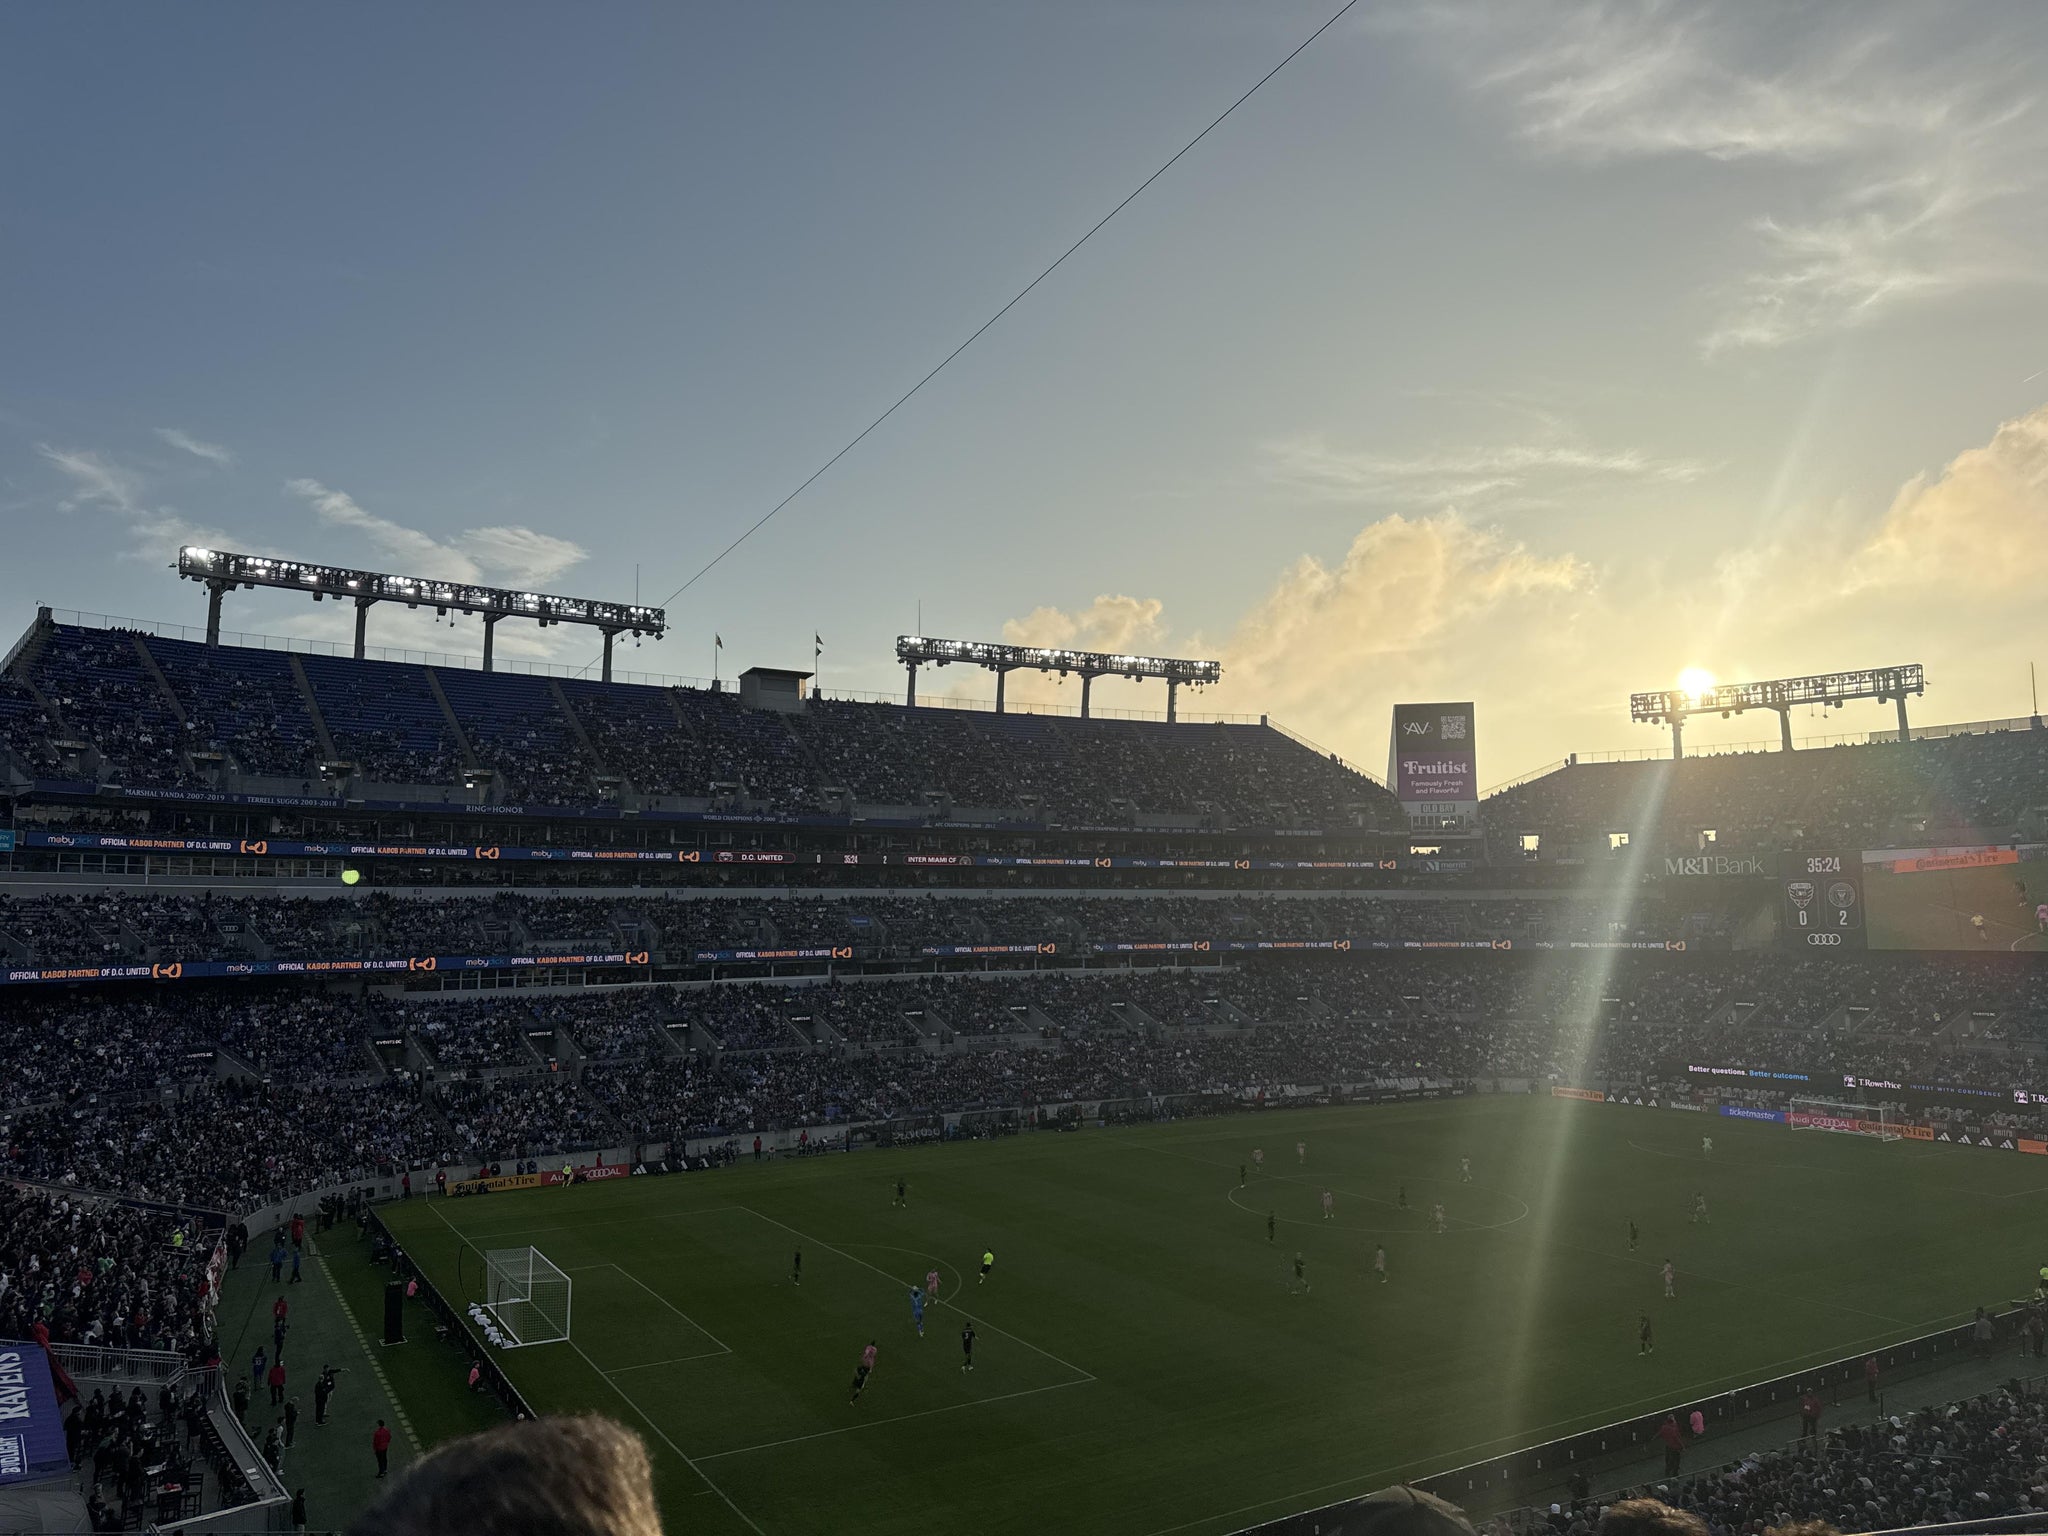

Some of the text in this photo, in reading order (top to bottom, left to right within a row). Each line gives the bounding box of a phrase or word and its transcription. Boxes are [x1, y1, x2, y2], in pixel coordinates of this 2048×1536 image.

[1404, 760, 1468, 774] Fruitist
[125, 788, 225, 801] MARSHAL YANDA 2007-2019
[1423, 804, 1454, 812] OLD BAY
[48, 835, 92, 846] mobydick
[305, 845, 344, 853] mobydick
[817, 855, 821, 863] 0
[844, 855, 858, 864] 35:24
[883, 856, 887, 864] 2
[1976, 854, 1999, 863] Tire
[1665, 856, 1764, 875] M&T Bank
[1807, 857, 1840, 872] 35:24
[1799, 910, 1807, 925] 0
[1840, 910, 1848, 925] 2
[466, 958, 504, 966] mobydick
[227, 965, 270, 973] mobydick
[10, 972, 39, 980] OFFICIAL
[1712, 1068, 1748, 1076] questions.
[1773, 1072, 1810, 1080] outcomes.
[1589, 1091, 1603, 1100] Tire
[1671, 1102, 1701, 1111] Heineken
[1729, 1108, 1776, 1120] ticketmaster
[1790, 1116, 1809, 1124] Audi
[1858, 1120, 1931, 1137] Continental Tire
[516, 1176, 534, 1186] Tire
[0, 1352, 32, 1422] RAVENS
[0, 1436, 21, 1474] BUD LIGHT
